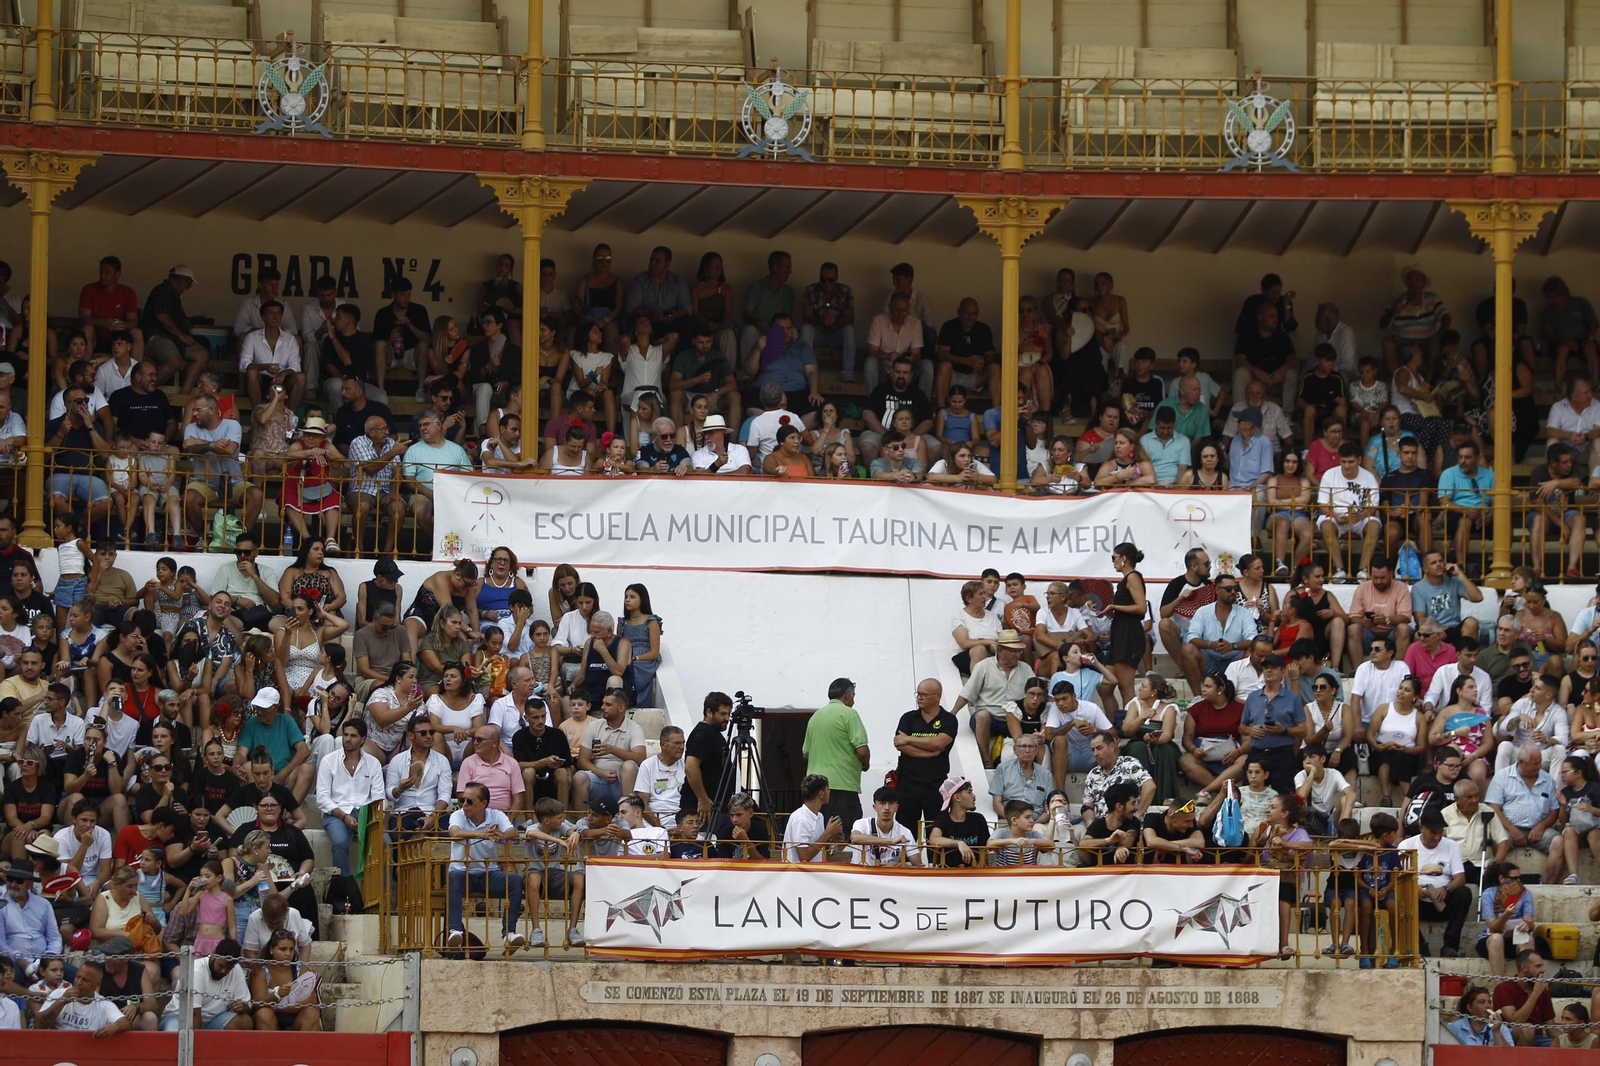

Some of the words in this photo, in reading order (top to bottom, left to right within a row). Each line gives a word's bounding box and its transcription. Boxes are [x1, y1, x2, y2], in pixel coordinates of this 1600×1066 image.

[534, 511, 660, 542] ESCUELA
[667, 512, 825, 545] MUNICIPAL
[832, 516, 958, 551] TAURINA
[966, 524, 1004, 554] DE
[1011, 518, 1137, 555] ALMERÍA
[714, 894, 901, 932] LANCES
[916, 906, 949, 932] DE
[965, 896, 1154, 932] FUTURO
[604, 986, 620, 999] SE
[626, 985, 684, 1001] COMENZÓ
[688, 987, 720, 1001] ESTA
[725, 987, 768, 1002] PLAZA
[772, 988, 790, 1002] EL
[796, 988, 810, 1002] 19
[816, 988, 834, 1003] DE
[841, 988, 925, 1004] SEPTIEMBRE
[931, 990, 948, 1004] DE
[989, 991, 1005, 1004] SE
[1010, 988, 1078, 1005] INAUGURÓ
[1083, 991, 1101, 1005] EL
[1105, 991, 1120, 1005] 26
[1126, 991, 1143, 1005] DE
[1148, 991, 1199, 1005] AGOSTO
[1203, 991, 1221, 1005] DE
